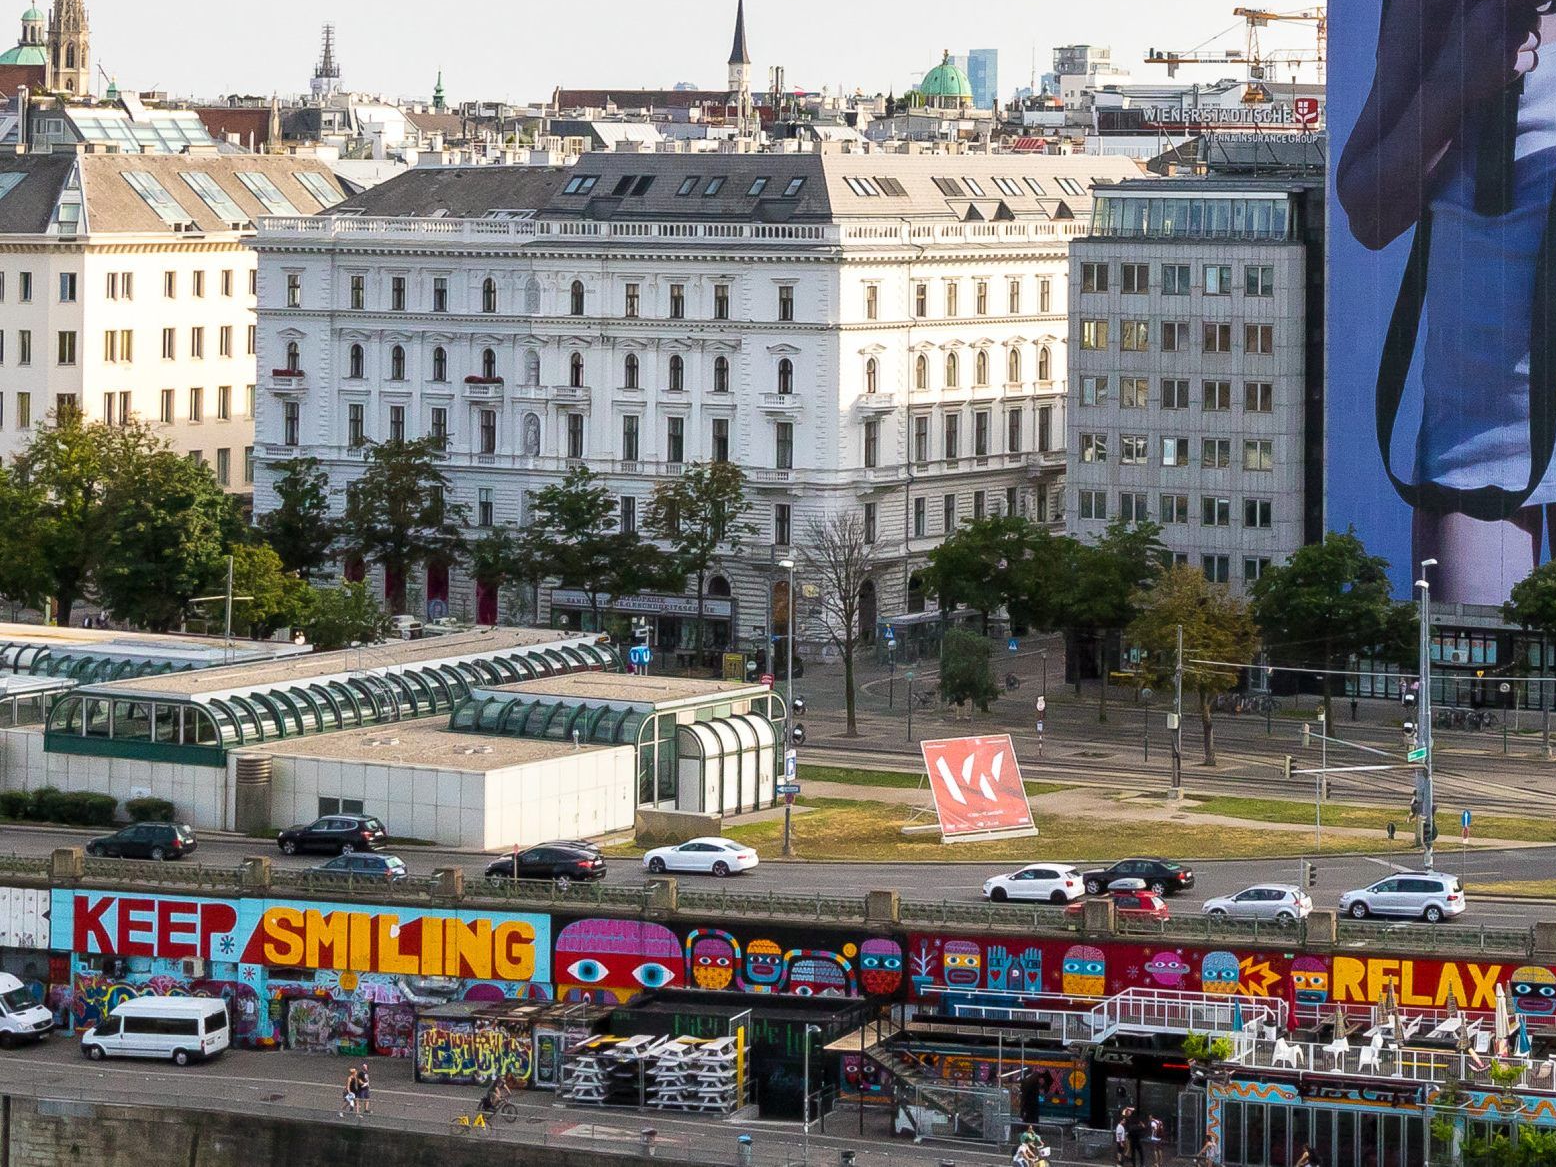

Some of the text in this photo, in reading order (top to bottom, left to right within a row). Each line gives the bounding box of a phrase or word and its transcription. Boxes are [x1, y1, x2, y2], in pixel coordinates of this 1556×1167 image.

[1143, 108, 1200, 122] WIENER
[74, 896, 536, 981] KEEP SMILING
[1332, 956, 1502, 1008] RELAX
